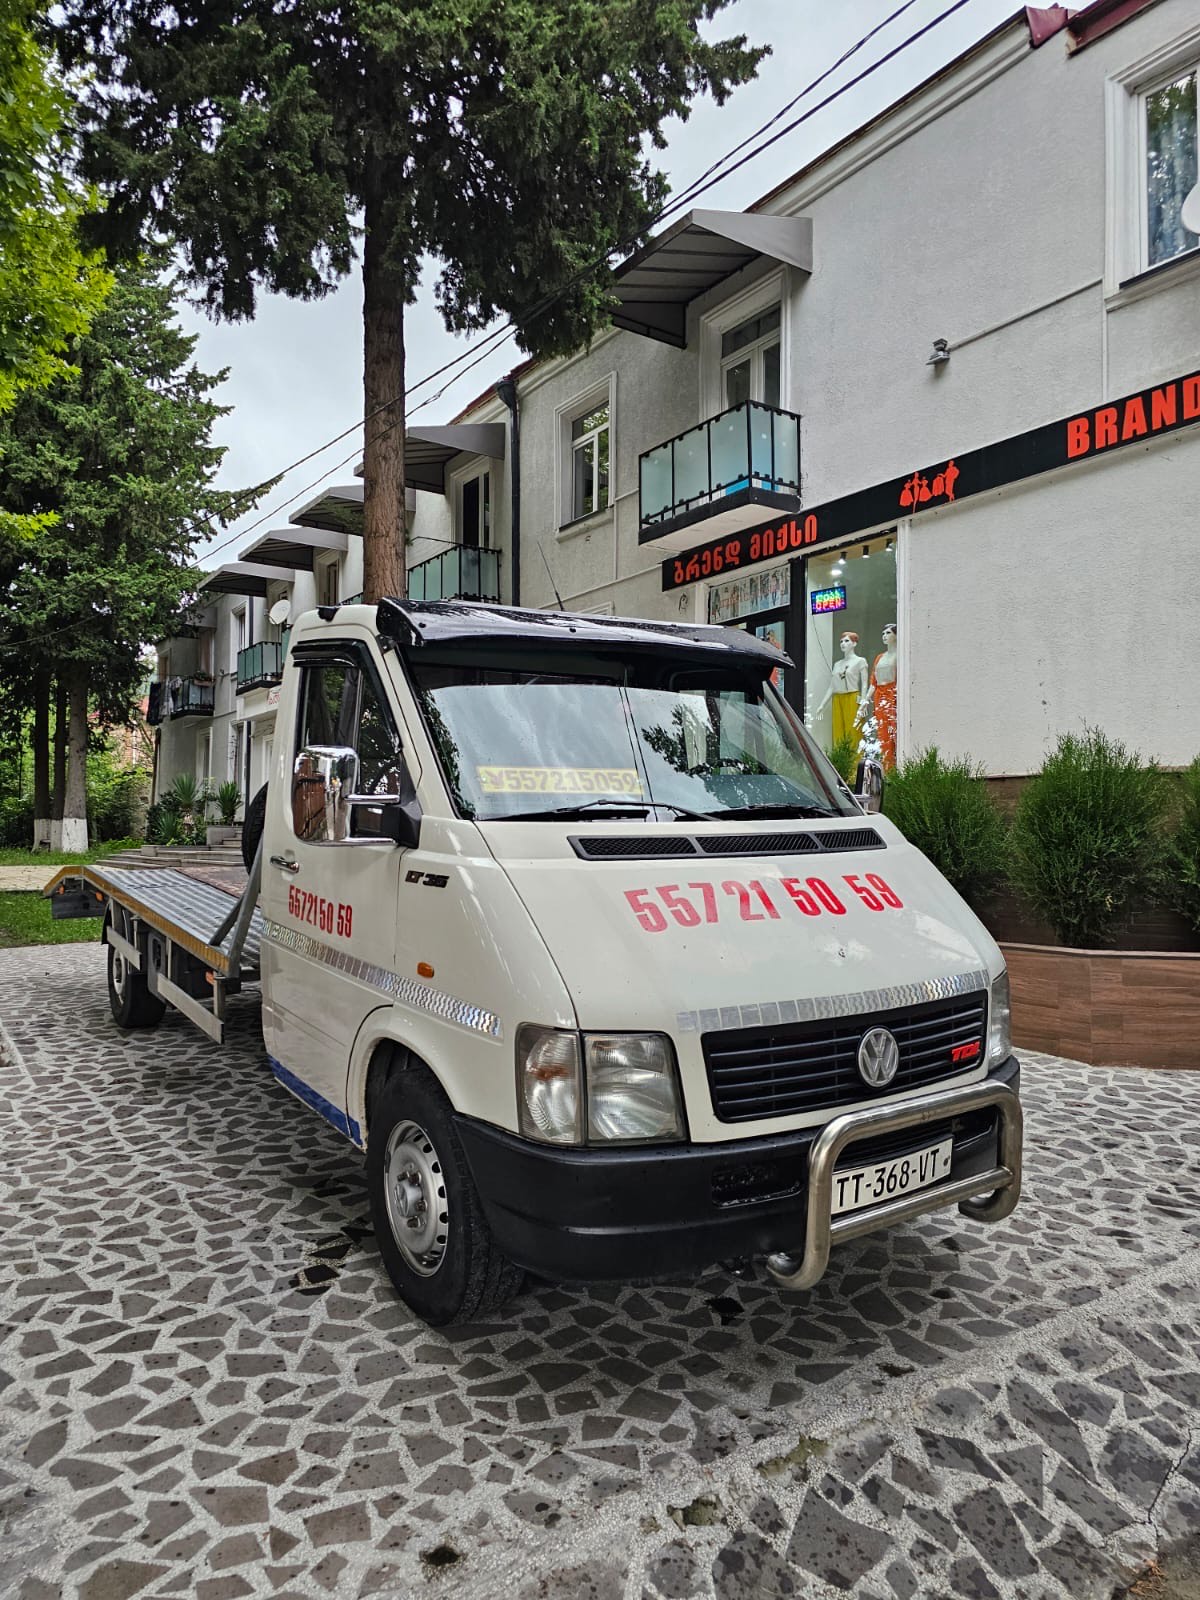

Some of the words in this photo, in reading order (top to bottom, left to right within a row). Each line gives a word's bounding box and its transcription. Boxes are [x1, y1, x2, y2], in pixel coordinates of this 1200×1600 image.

[1067, 375, 1200, 458] BRAND
[674, 540, 741, 584] ბრენდ
[750, 514, 818, 560] მიქსი
[816, 597, 842, 610] OPEN
[504, 769, 637, 793] 557215059
[841, 872, 904, 912] 59
[337, 903, 353, 938] 59
[951, 1041, 980, 1062] TDI
[836, 1147, 940, 1208] TT-368-VT
